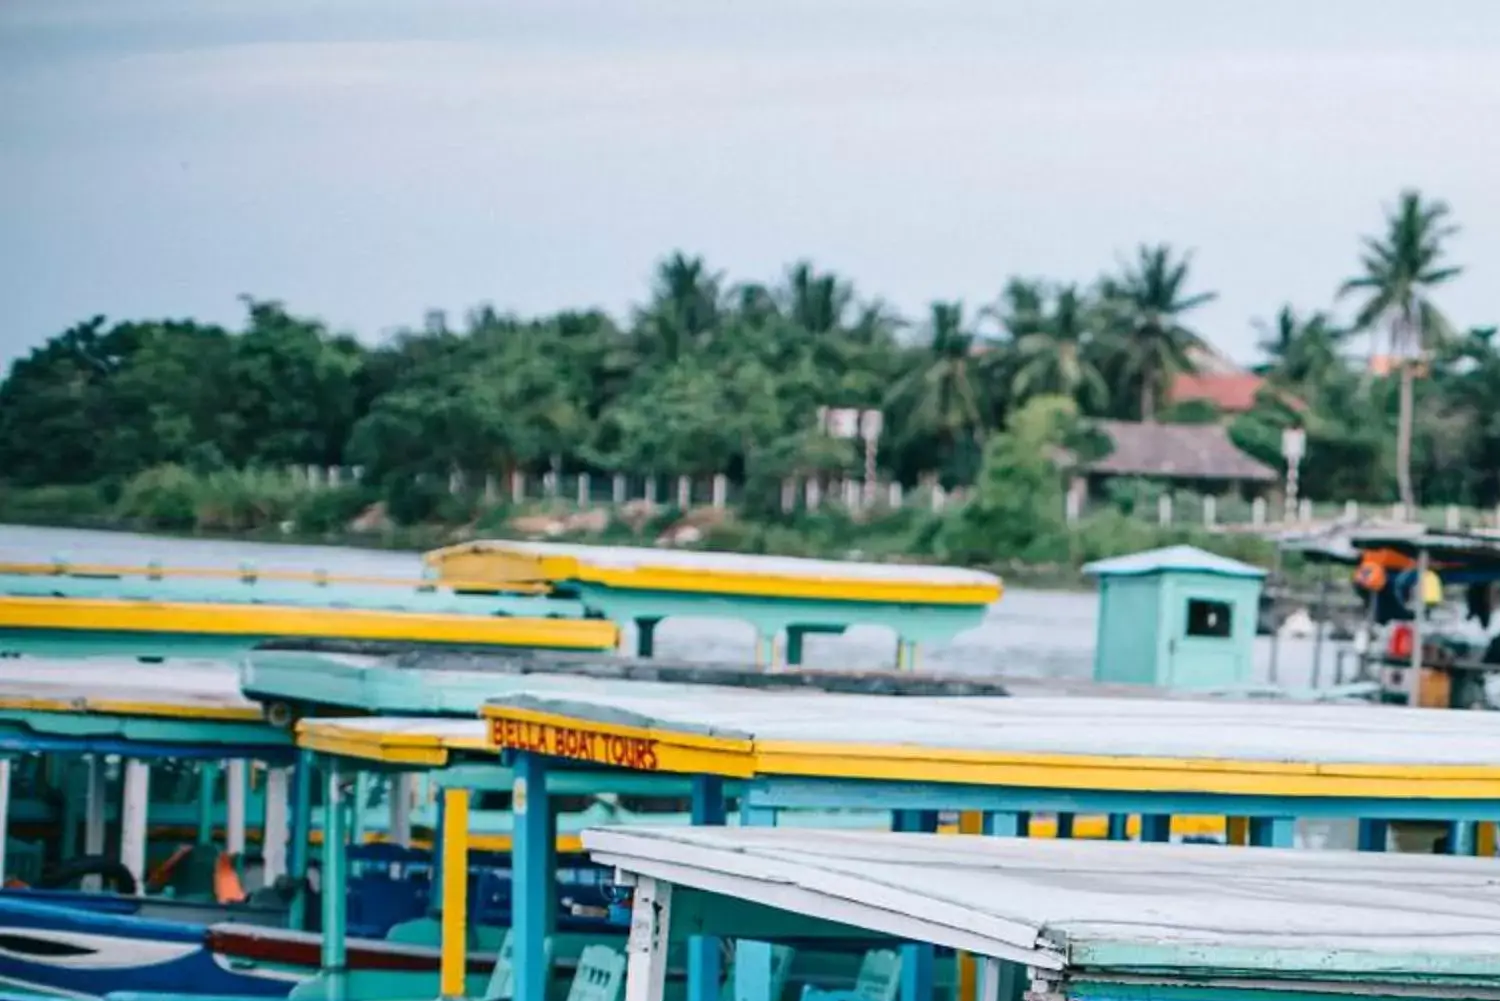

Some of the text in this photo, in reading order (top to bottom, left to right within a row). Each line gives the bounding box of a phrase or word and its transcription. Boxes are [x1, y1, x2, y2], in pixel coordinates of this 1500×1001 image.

[493, 719, 658, 769] BELLA BOAT TOURS
